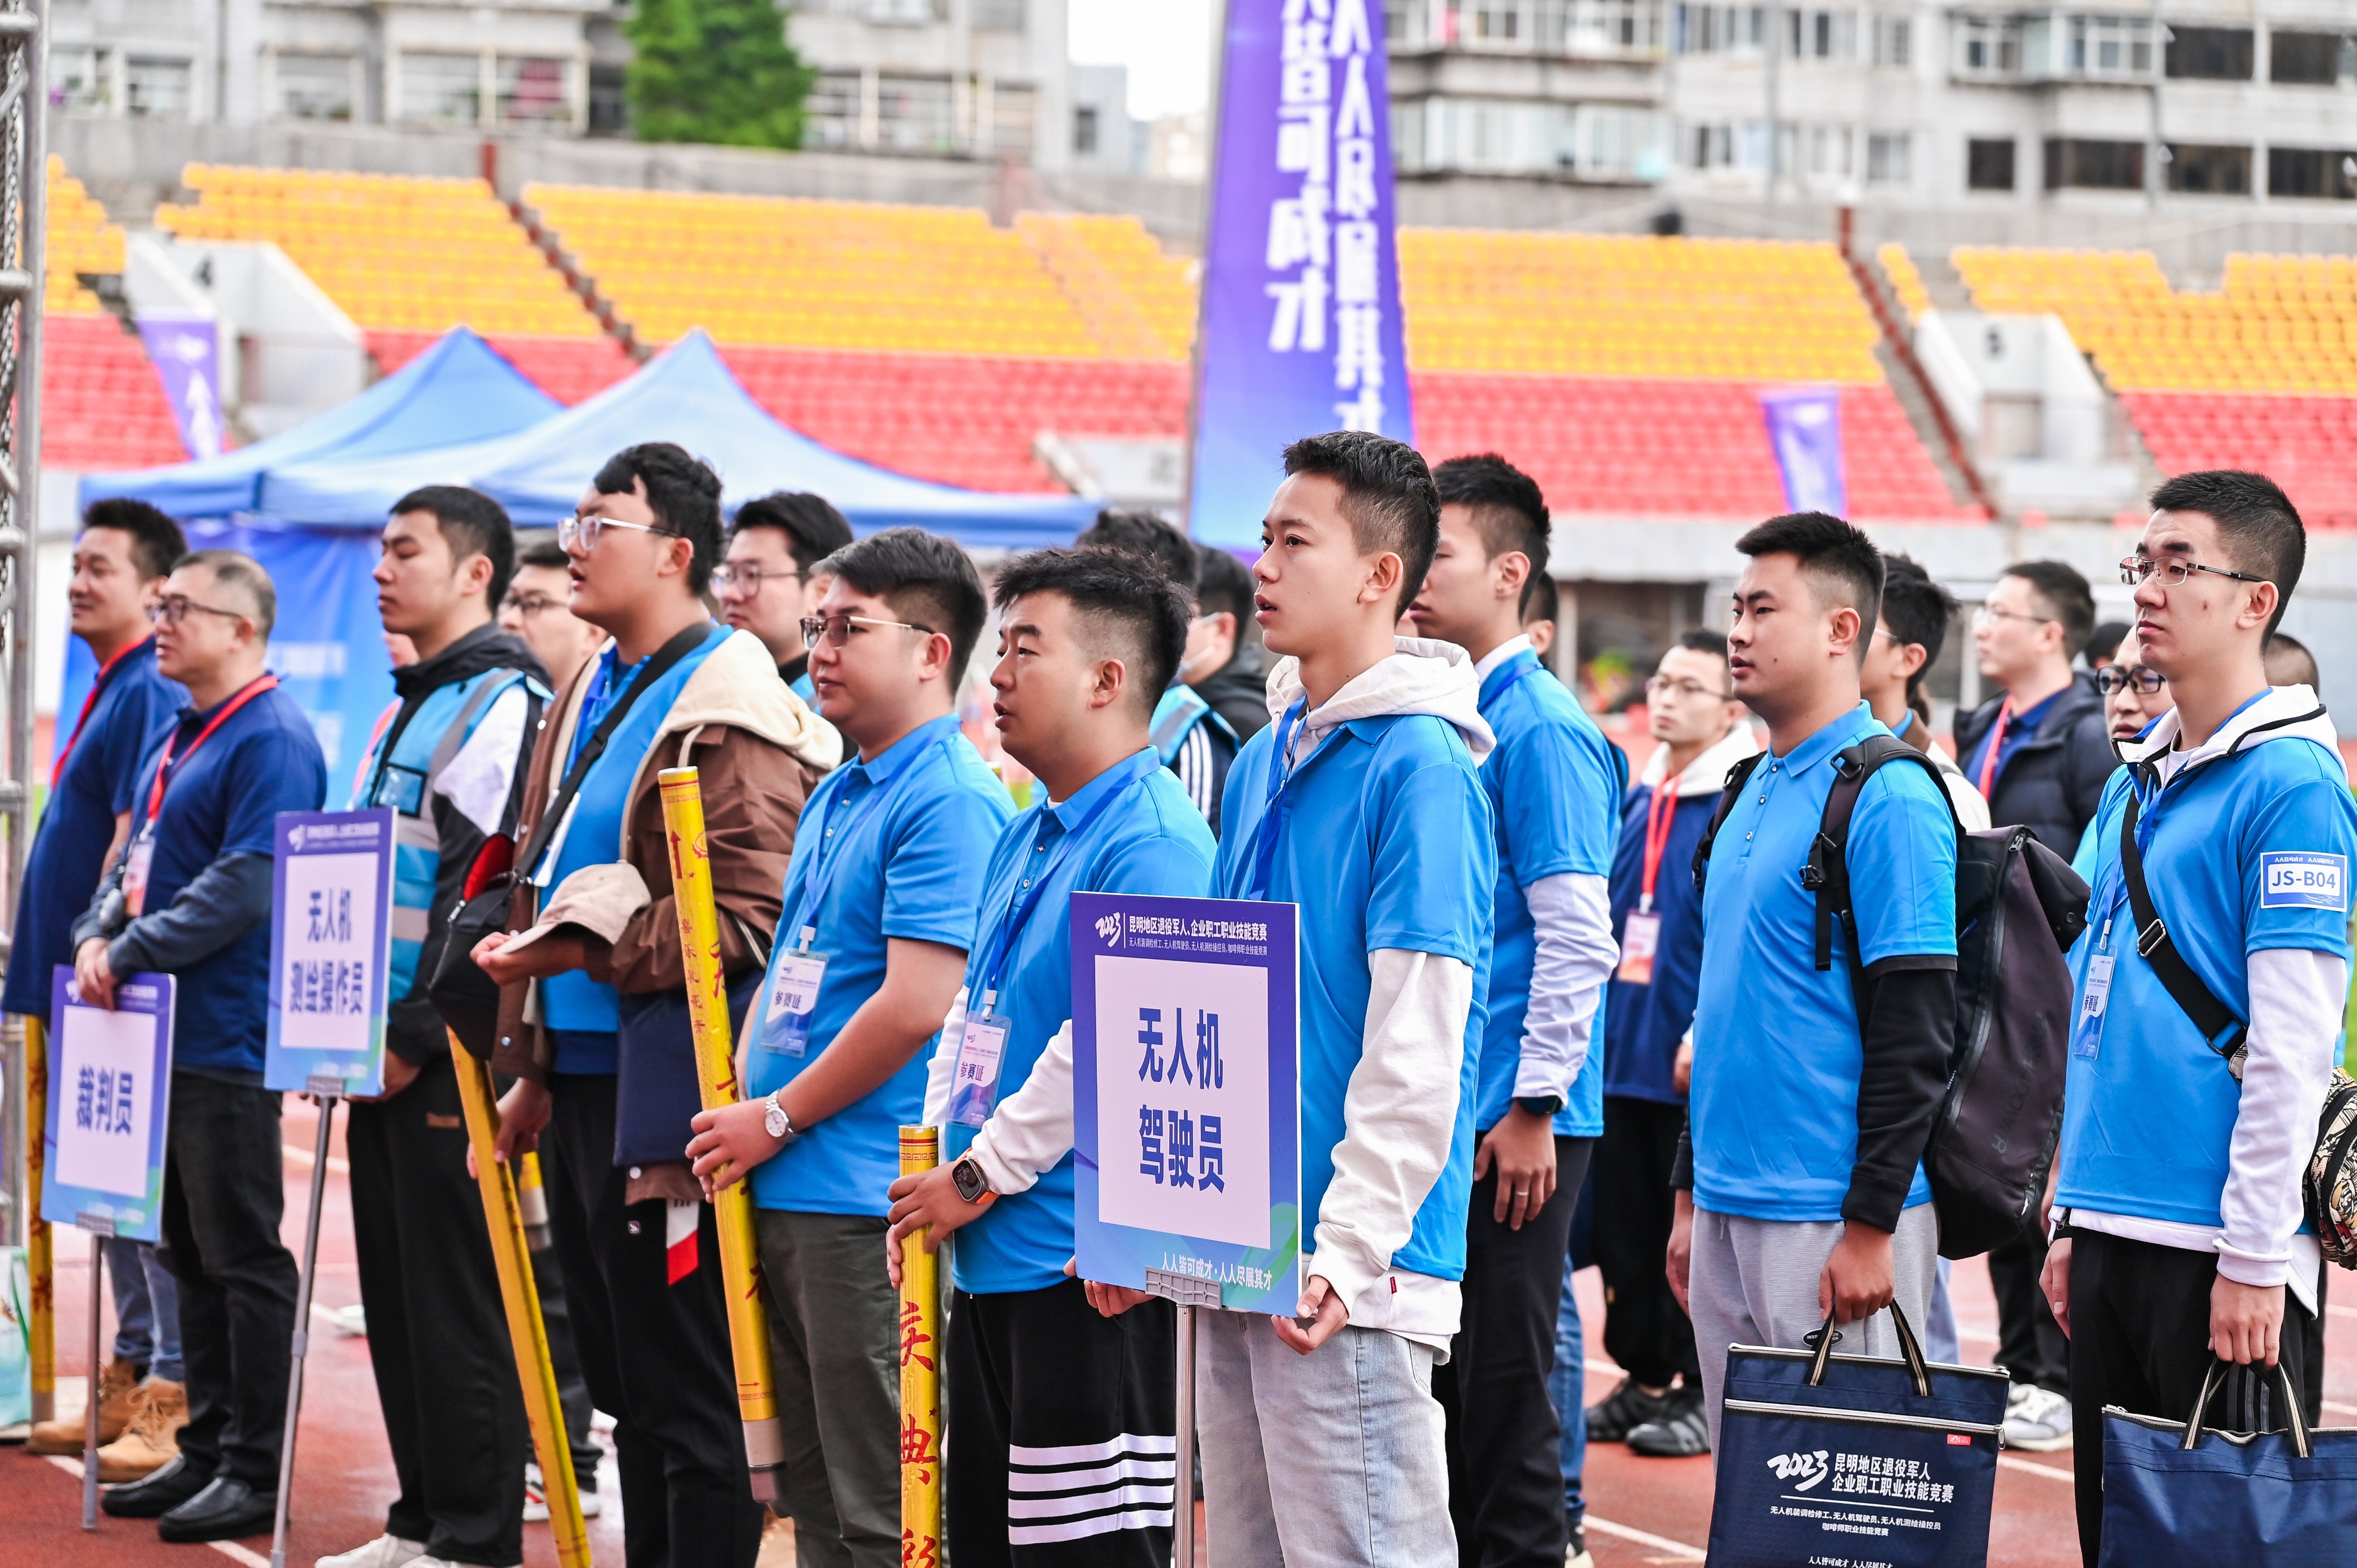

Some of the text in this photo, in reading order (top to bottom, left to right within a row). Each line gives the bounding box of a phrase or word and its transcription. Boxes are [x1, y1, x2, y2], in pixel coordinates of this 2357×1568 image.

[2271, 870, 2336, 889] JS-B04
[307, 888, 351, 942] 无人机
[1094, 912, 1267, 947] 2023 昆明地区退役军人、企业职工职业技能竞赛
[775, 991, 802, 1009] 参赛证
[2083, 994, 2099, 1012] 参赛证
[1138, 1007, 1223, 1090] 无人机
[959, 1061, 985, 1082] 参赛证
[77, 1064, 133, 1135] 裁判员
[1139, 1104, 1225, 1195] 驾驶员
[1766, 1450, 1931, 1491] 2023 昆明地区退役军人
[1831, 1473, 1955, 1503] 企业职工职业技能竞赛
[1770, 1506, 1942, 1531] 无人机装调检修工、无人机驾驶员、无人机测绘操控员
[1822, 1523, 1889, 1537] 咖啡师职业技能竞赛
